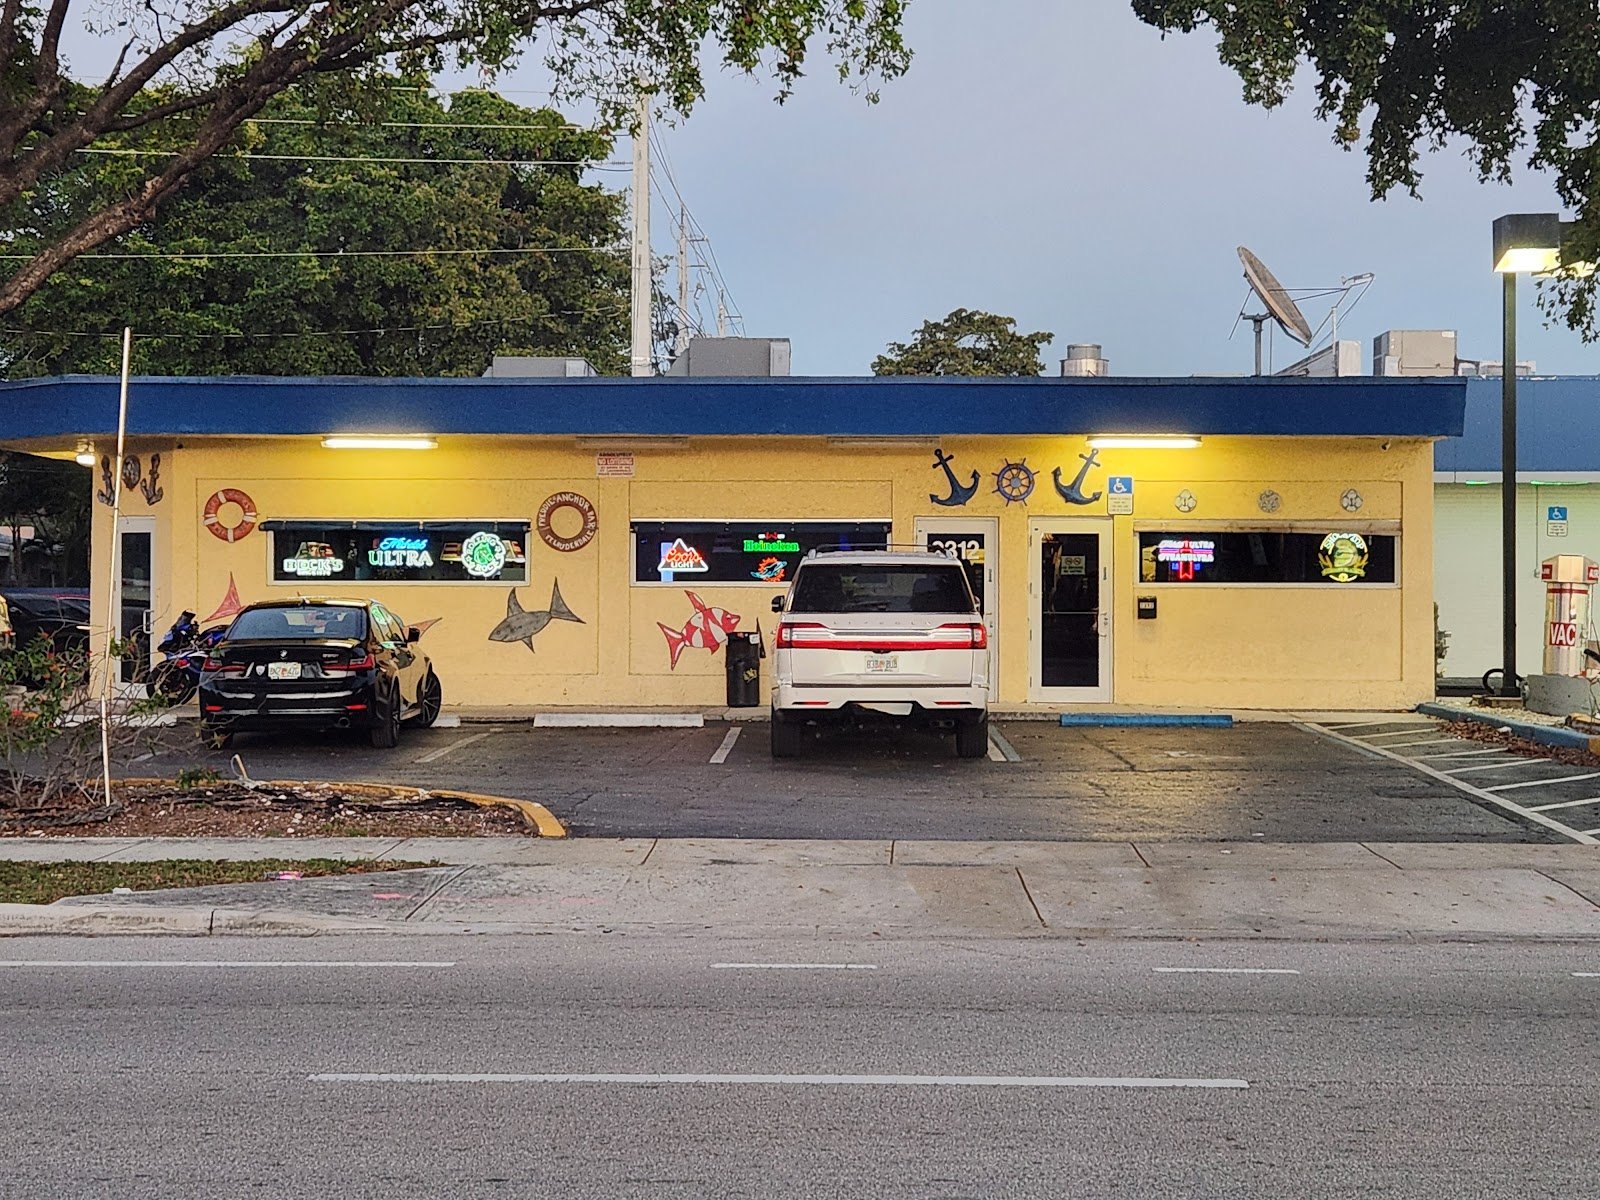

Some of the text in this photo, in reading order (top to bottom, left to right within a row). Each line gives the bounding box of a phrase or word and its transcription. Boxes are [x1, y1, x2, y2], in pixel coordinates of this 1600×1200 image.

[556, 493, 589, 511] ANCHOR
[743, 540, 800, 552] Heineken
[368, 550, 434, 567] ULTRA
[665, 548, 702, 562] Coors
[1551, 624, 1576, 646] VAC
